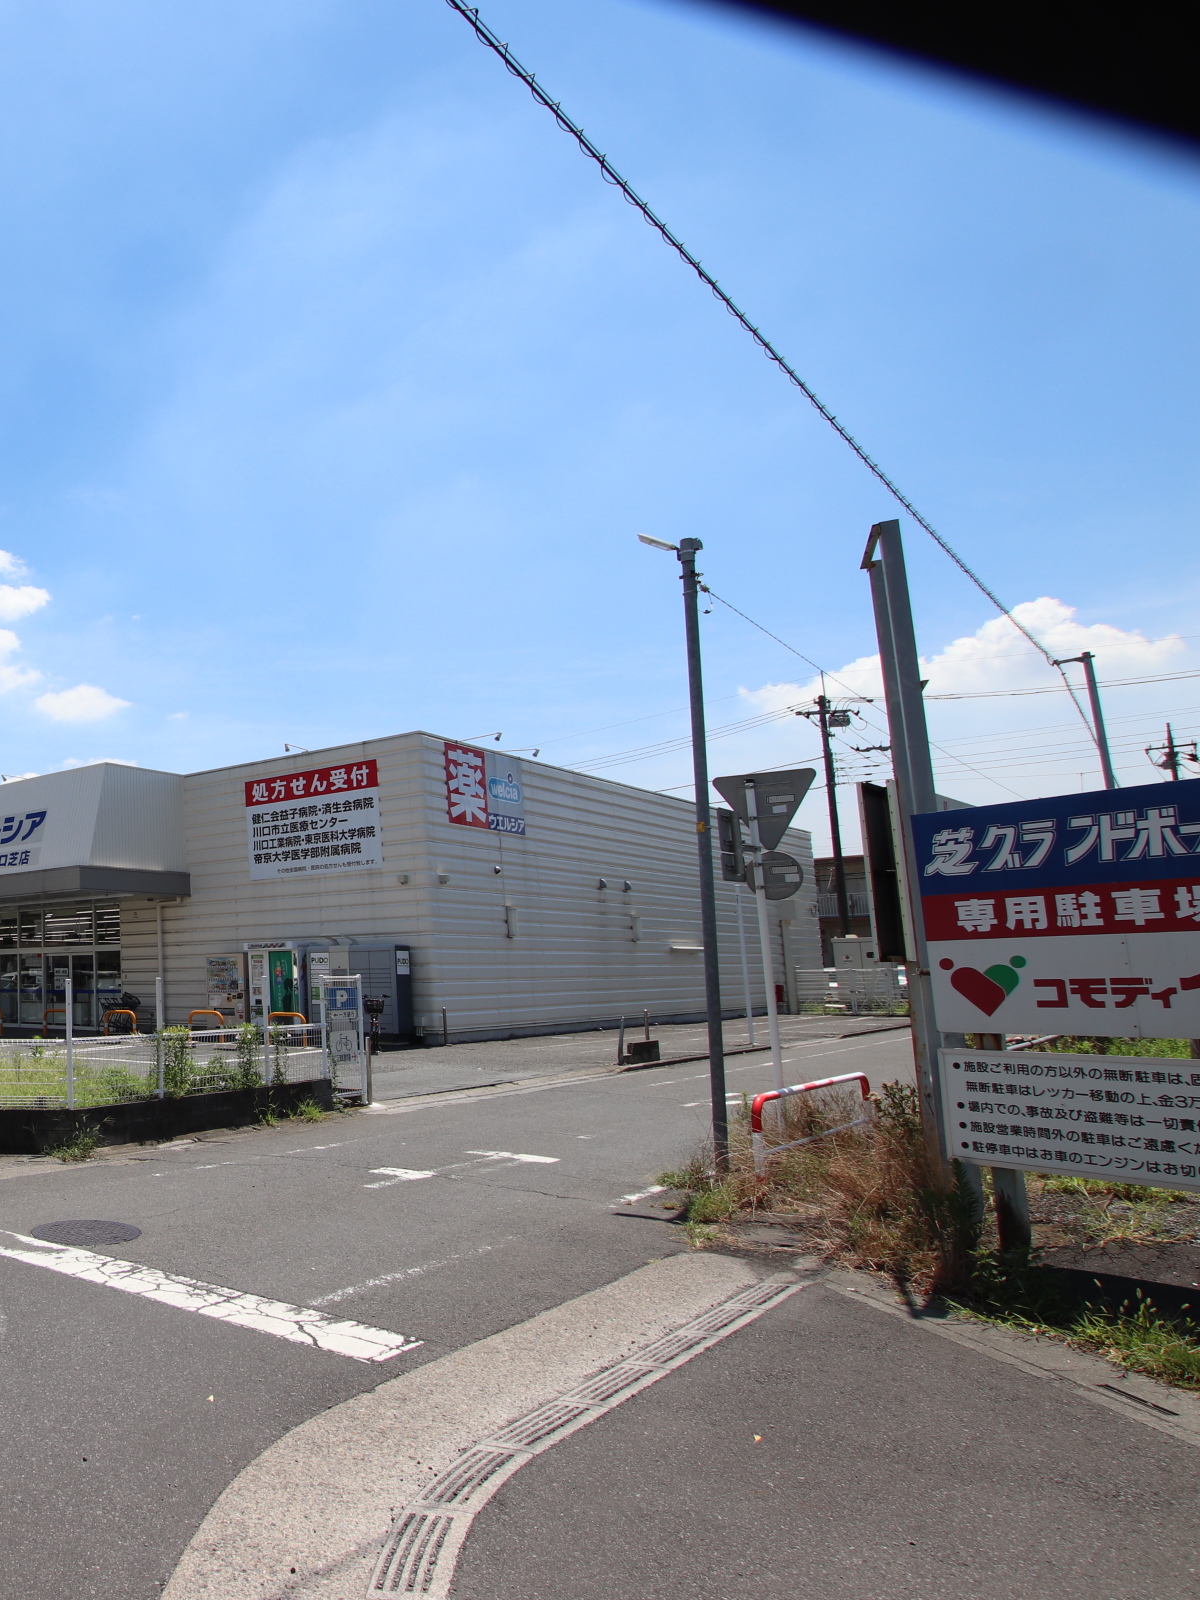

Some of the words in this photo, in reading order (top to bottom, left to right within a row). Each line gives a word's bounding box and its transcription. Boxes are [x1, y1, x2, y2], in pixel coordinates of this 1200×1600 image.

[252, 765, 370, 803] 処方せん受付
[448, 749, 486, 823] 薬
[490, 783, 518, 800] welcia
[253, 817, 349, 838] 川口市立医療センター
[489, 814, 525, 833] ウエルシア
[254, 842, 362, 864] 帝京大学医学部附属病院
[924, 805, 1200, 877] 芝グランドボー
[336, 990, 348, 1007] P
[968, 1100, 1200, 1132] 場内での、事故及び盗難等は一切責
[972, 1141, 1200, 1178] 駐停車中はお車のエンジンはお切
